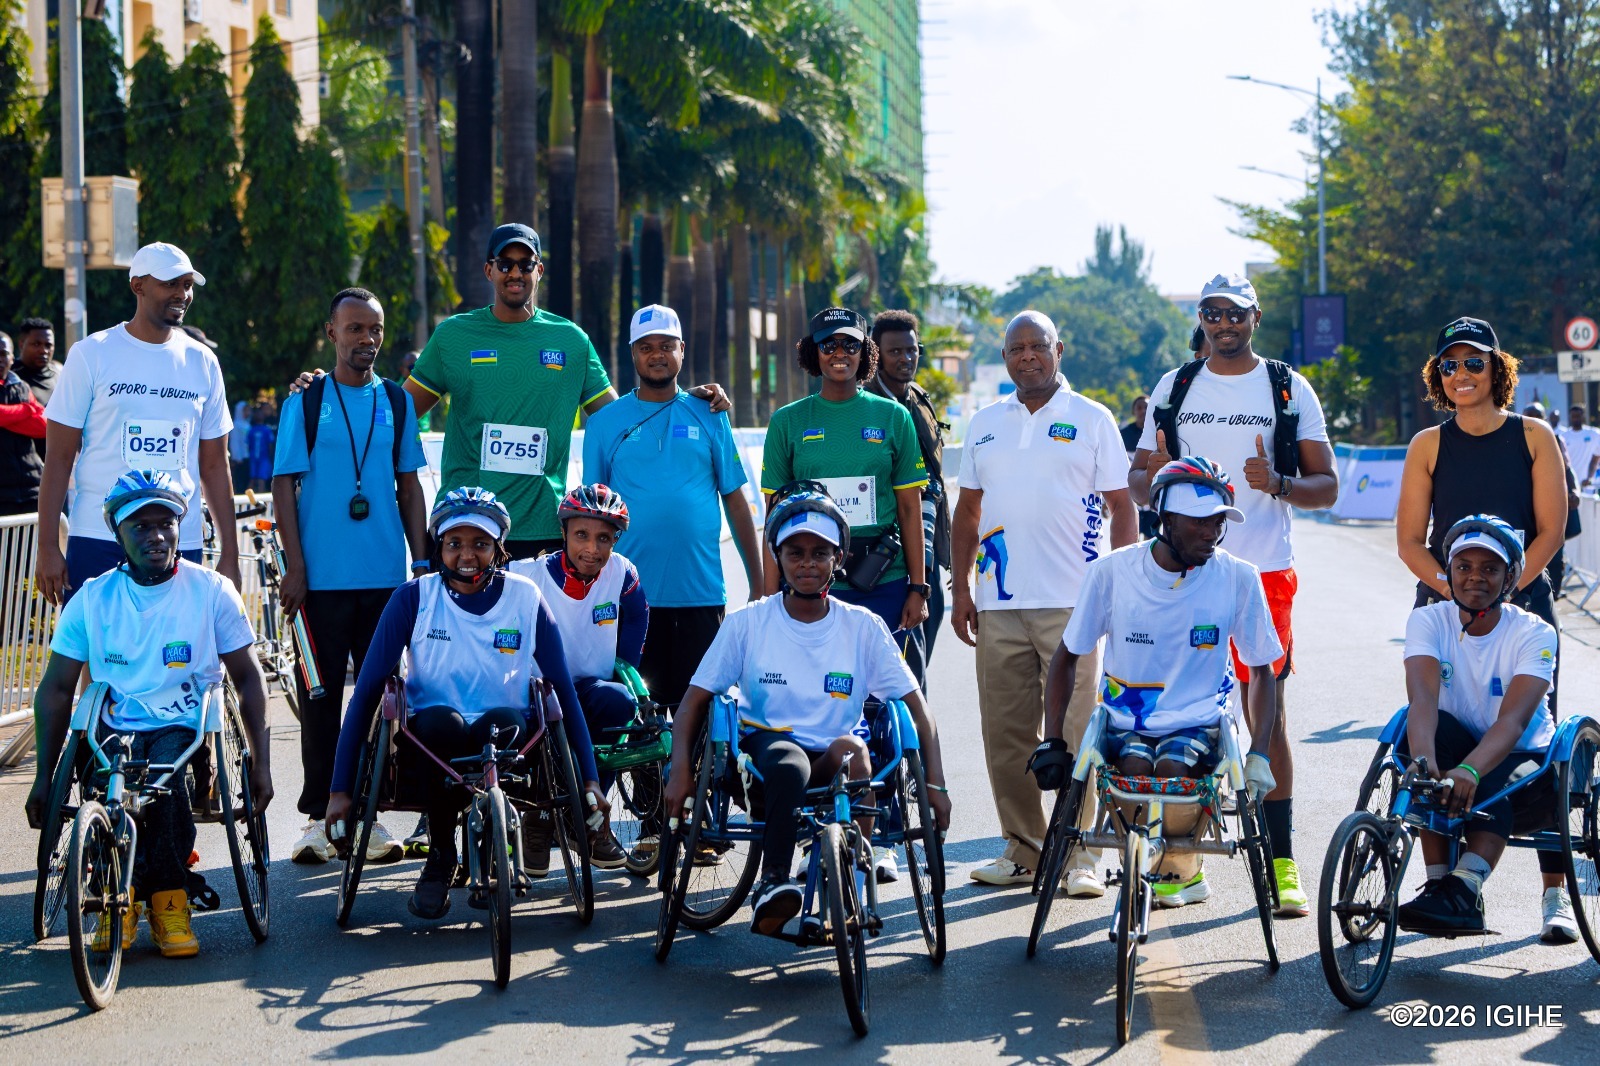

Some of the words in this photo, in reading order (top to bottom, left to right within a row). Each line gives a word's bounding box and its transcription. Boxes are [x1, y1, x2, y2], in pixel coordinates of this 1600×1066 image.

[1572, 326, 1590, 341] 60
[542, 351, 564, 361] PEACE
[108, 383, 148, 398] SIPORO
[160, 387, 199, 402] UBUZIMA
[1176, 412, 1214, 427] SIPORO
[1228, 414, 1273, 428] UBUZIMA
[129, 437, 177, 454] 0521
[490, 440, 538, 458] 0755
[832, 497, 852, 508] LLY
[852, 497, 862, 506] M.
[594, 606, 615, 616] PEACE
[426, 632, 452, 642] RWANDA
[431, 628, 447, 636] VISIT
[1130, 631, 1149, 639] VISIT
[1193, 629, 1217, 640] PEACE
[497, 633, 519, 643] PEACE
[1125, 636, 1155, 646] RWANDA
[166, 646, 188, 657] PEACE
[104, 657, 129, 666] RWANDA
[764, 672, 783, 680] VISIT
[758, 677, 788, 687] RWANDA
[827, 677, 852, 688] PEACE
